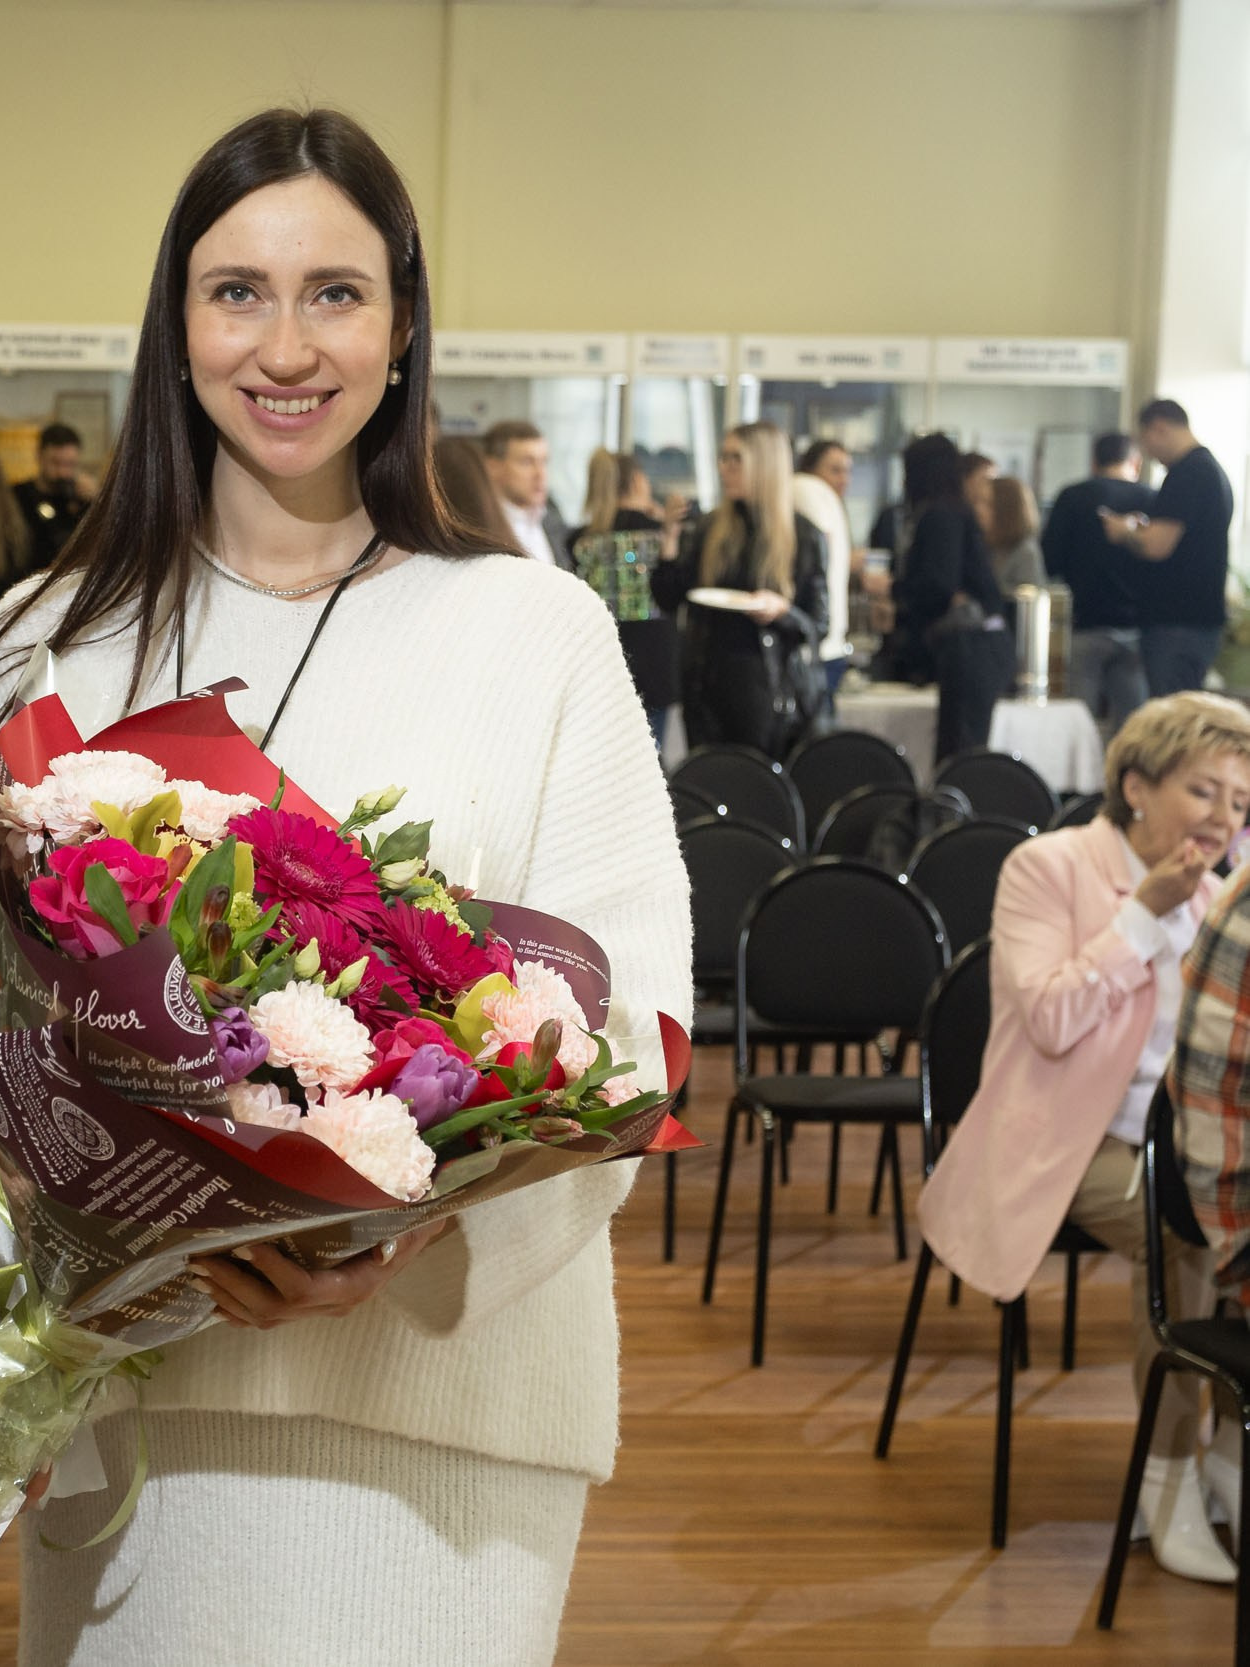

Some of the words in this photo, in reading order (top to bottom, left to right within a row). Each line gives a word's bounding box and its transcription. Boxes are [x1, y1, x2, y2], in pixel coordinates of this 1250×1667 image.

[524, 947, 536, 955] find
[537, 951, 563, 962] someone
[564, 957, 575, 965] like
[527, 939, 538, 948] this
[538, 943, 554, 951] great
[169, 961, 185, 1010] LOUVRE
[88, 1050, 142, 1071] Heartfelt
[147, 1047, 216, 1076] Compliment
[153, 1073, 175, 1093] day
[178, 1072, 199, 1093] for
[21, 1116, 65, 1185] Heartfelt
[179, 1176, 232, 1219] Heartfelt
[126, 1211, 189, 1256] Compliment
[43, 1238, 89, 1277] Good
